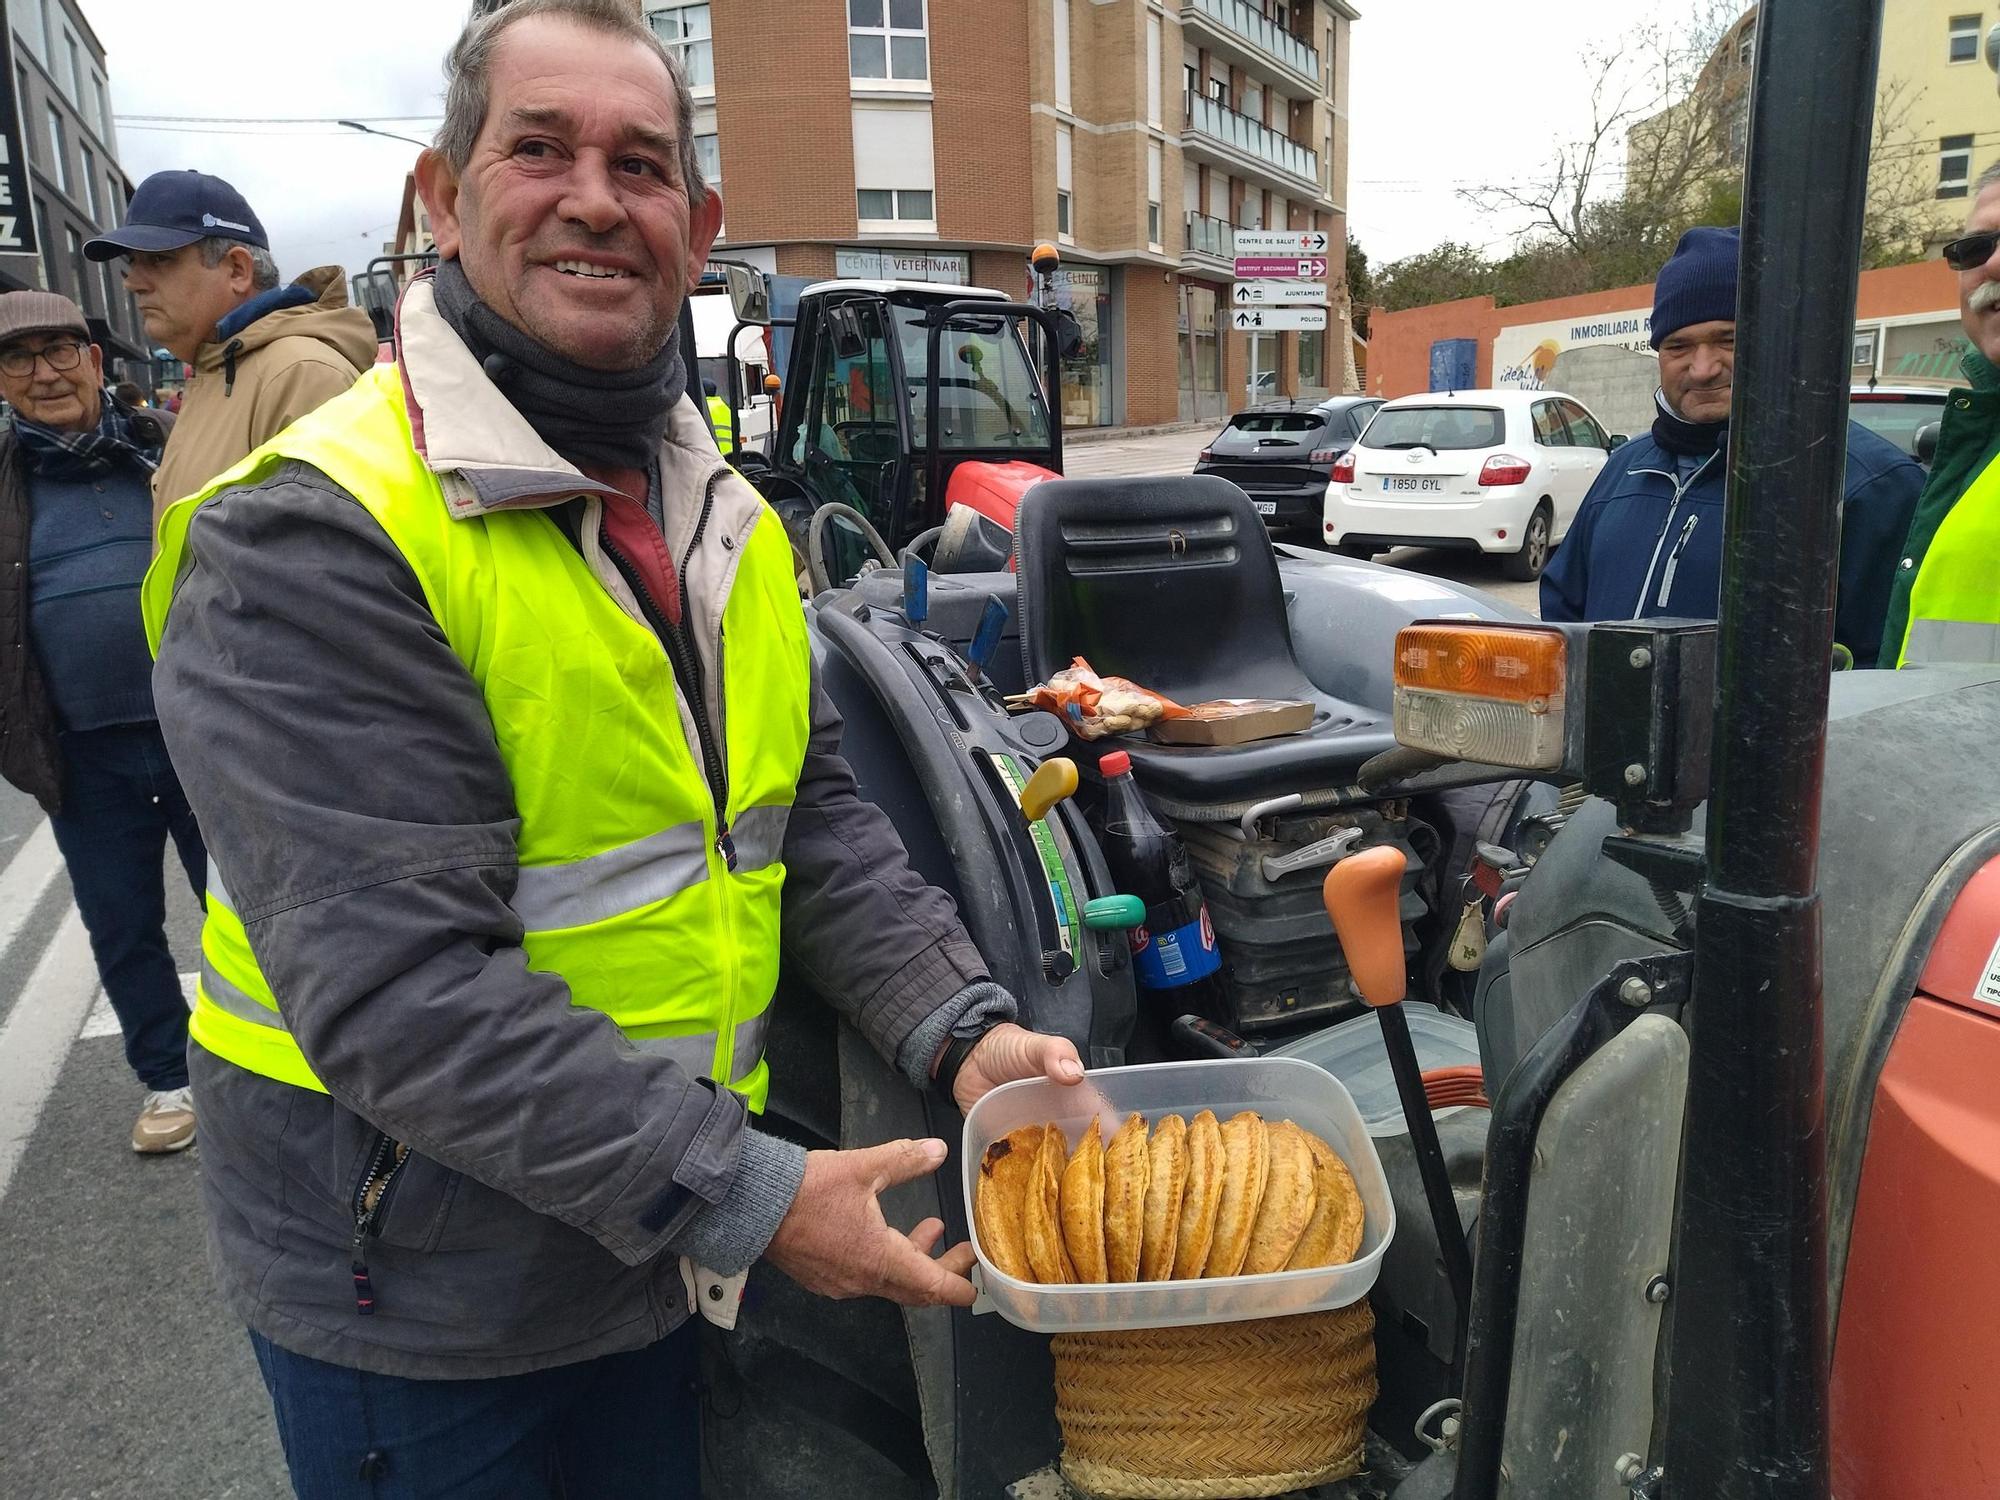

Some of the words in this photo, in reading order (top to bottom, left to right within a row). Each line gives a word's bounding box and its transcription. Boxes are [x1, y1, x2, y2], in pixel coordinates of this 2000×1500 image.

[845, 256, 889, 269] CENTRE
[893, 259, 961, 272] VETERINARI
[1571, 319, 1638, 340] INMOBILIARIA
[1643, 317, 1651, 332] R
[1392, 479, 1417, 490] 1850
[1421, 479, 1441, 490] GYL
